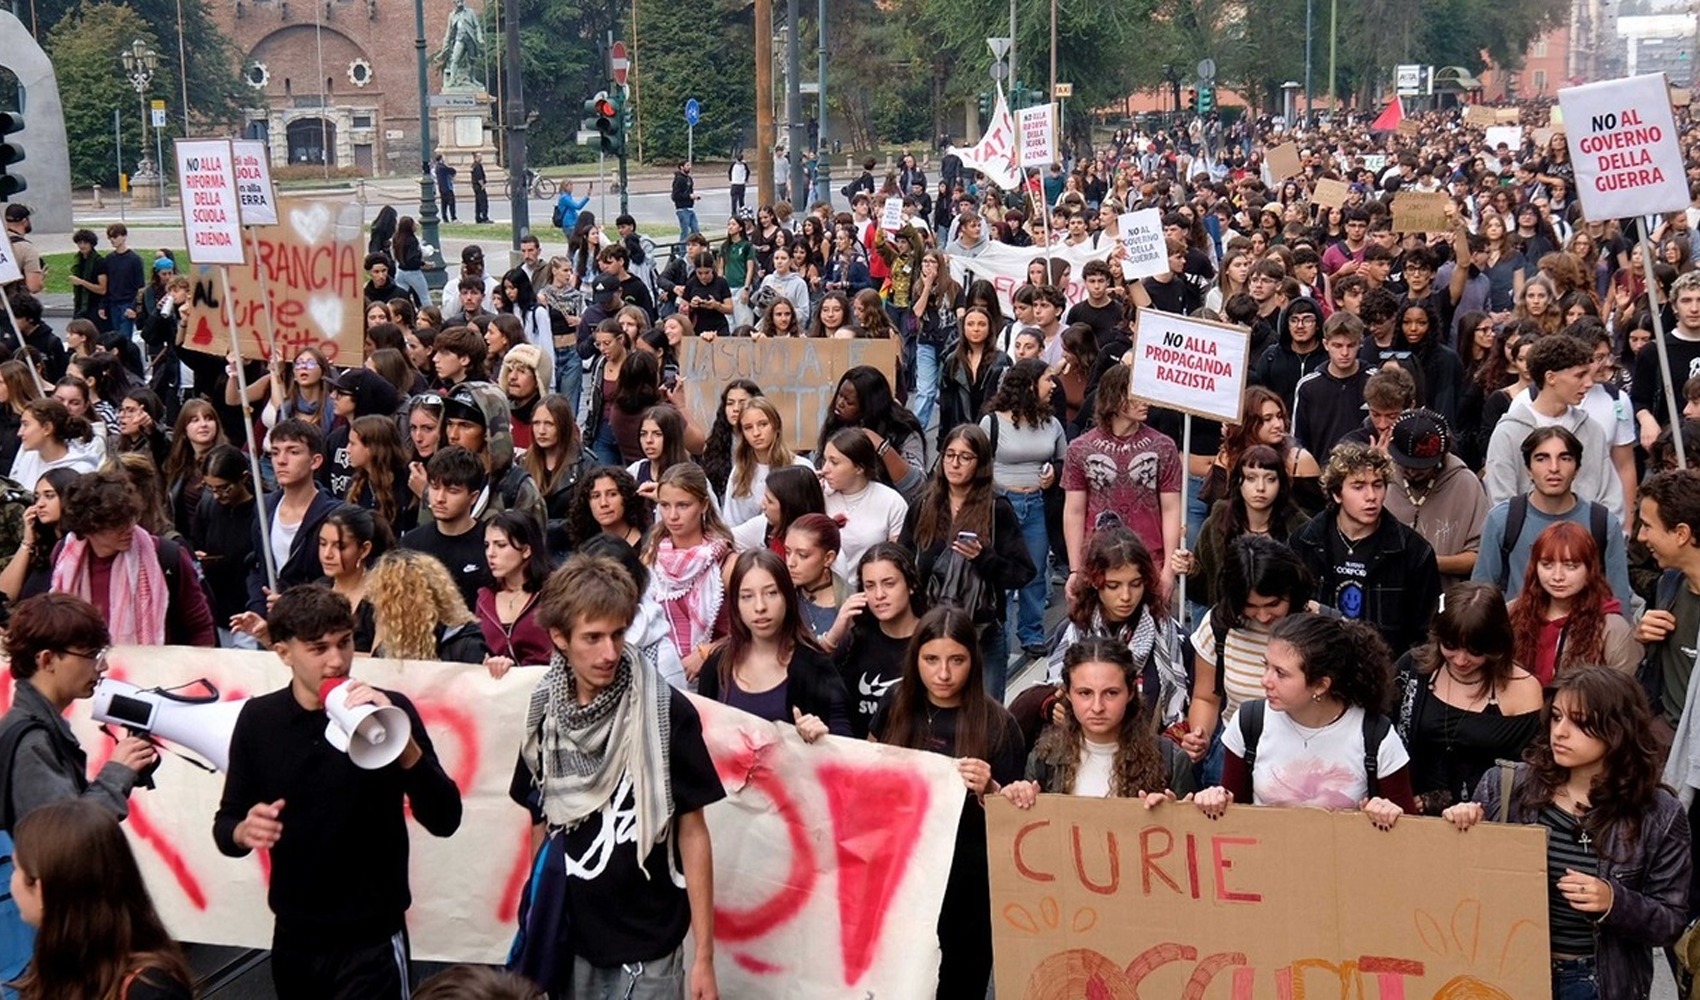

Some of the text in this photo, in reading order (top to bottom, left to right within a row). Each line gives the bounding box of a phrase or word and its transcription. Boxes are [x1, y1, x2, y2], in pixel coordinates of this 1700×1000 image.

[1024, 113, 1032, 121] NO
[1591, 109, 1643, 133] NO AL
[1027, 130, 1044, 139] DELLA
[1580, 126, 1662, 154] GOVERNO
[1026, 139, 1046, 148] SCUOLA
[186, 157, 222, 171] NO ALLA
[244, 156, 258, 166] alla
[1598, 148, 1653, 172] DELLA
[185, 175, 226, 189] RIFORMA
[1595, 166, 1665, 192] GUERRA
[246, 183, 262, 193] alla
[194, 192, 221, 206] DELLA
[193, 209, 227, 223] SCUOLA
[1128, 226, 1151, 236] NO AL
[195, 232, 232, 246] AZIENDA
[1123, 233, 1159, 247] GOVERNO
[1130, 243, 1155, 255] DELLA
[1129, 251, 1160, 264] GUERRA
[245, 241, 358, 299] RANCIA
[193, 279, 220, 309] AL
[1162, 331, 1218, 357] NO ALLA
[1145, 344, 1233, 378] PROPAGANDA
[1156, 365, 1216, 392] RAZZISTA
[1012, 819, 1262, 903] CURIE
